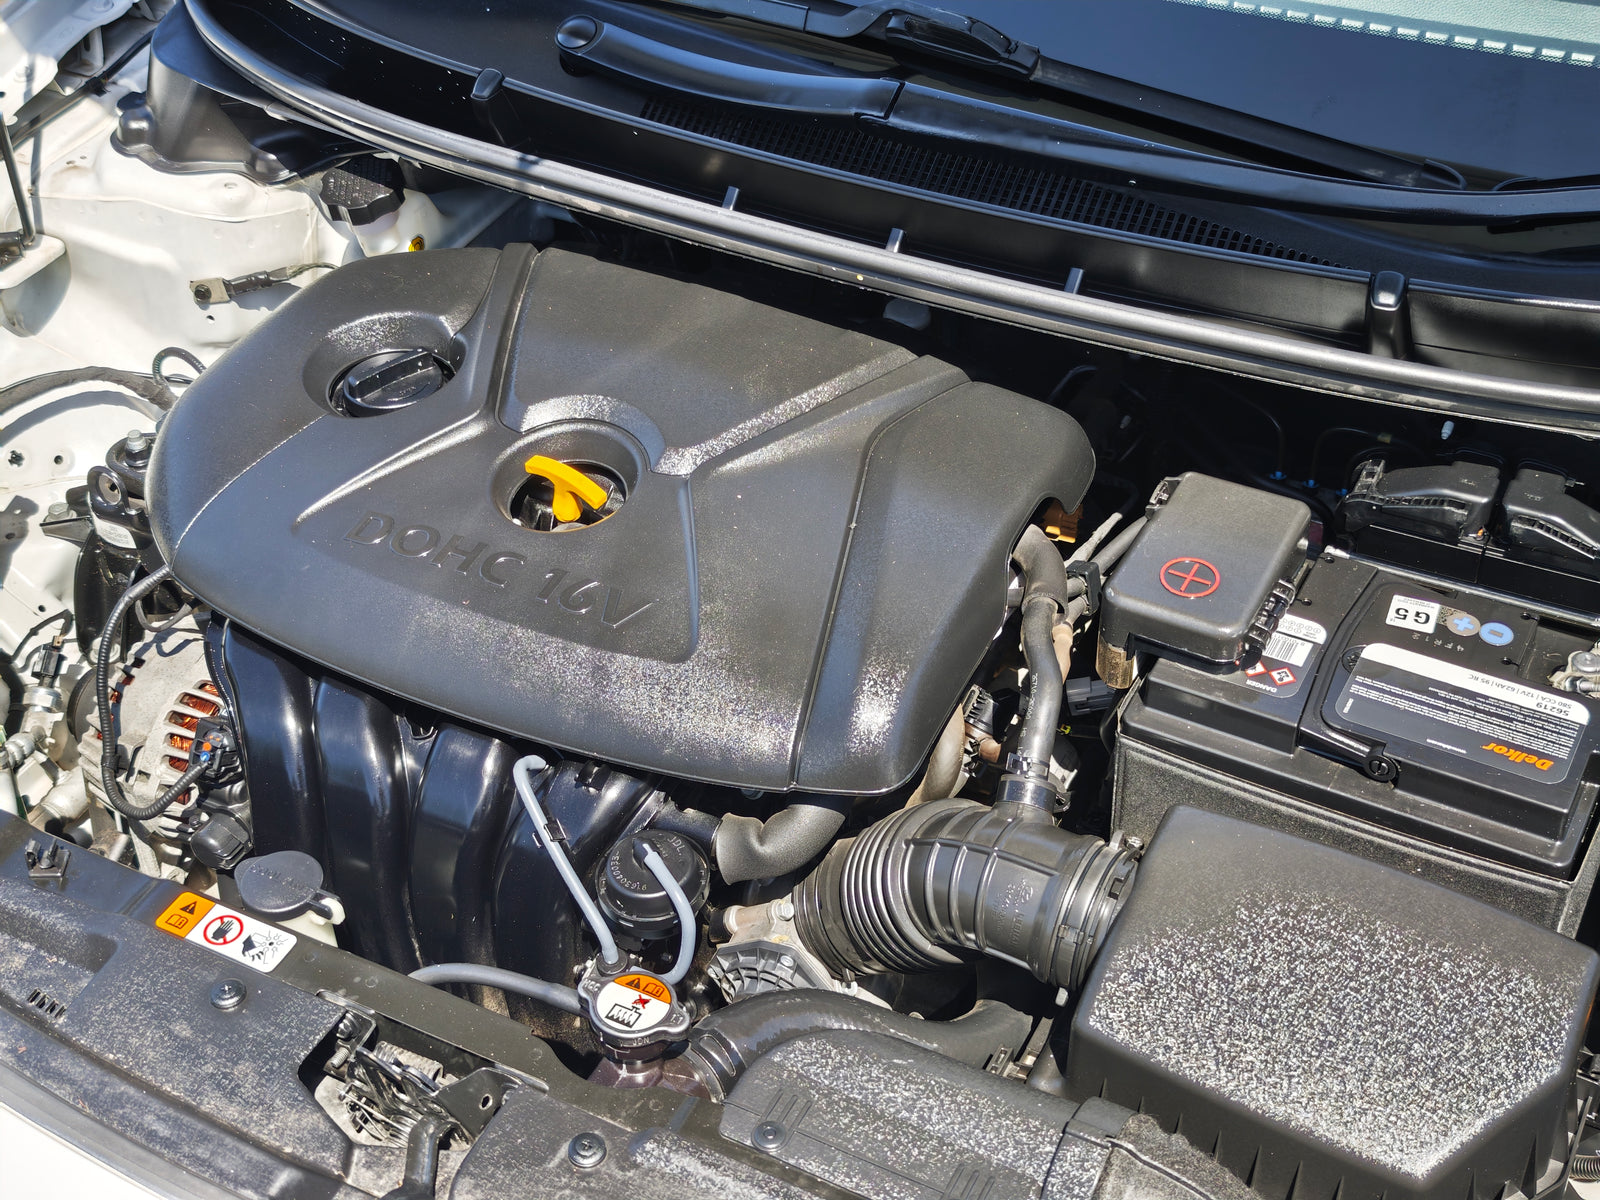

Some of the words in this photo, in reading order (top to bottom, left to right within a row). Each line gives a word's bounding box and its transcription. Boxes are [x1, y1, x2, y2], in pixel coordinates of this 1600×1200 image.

[343, 511, 528, 588] DOHC
[536, 568, 660, 628] 16V
[1245, 679, 1278, 693] DANGER
[1495, 682, 1516, 692] 62Ah
[1519, 690, 1535, 698] 12V
[1541, 695, 1557, 705] CCA
[1535, 702, 1570, 717] 56219
[1557, 701, 1573, 710] 580
[1482, 742, 1555, 771] Delkor
